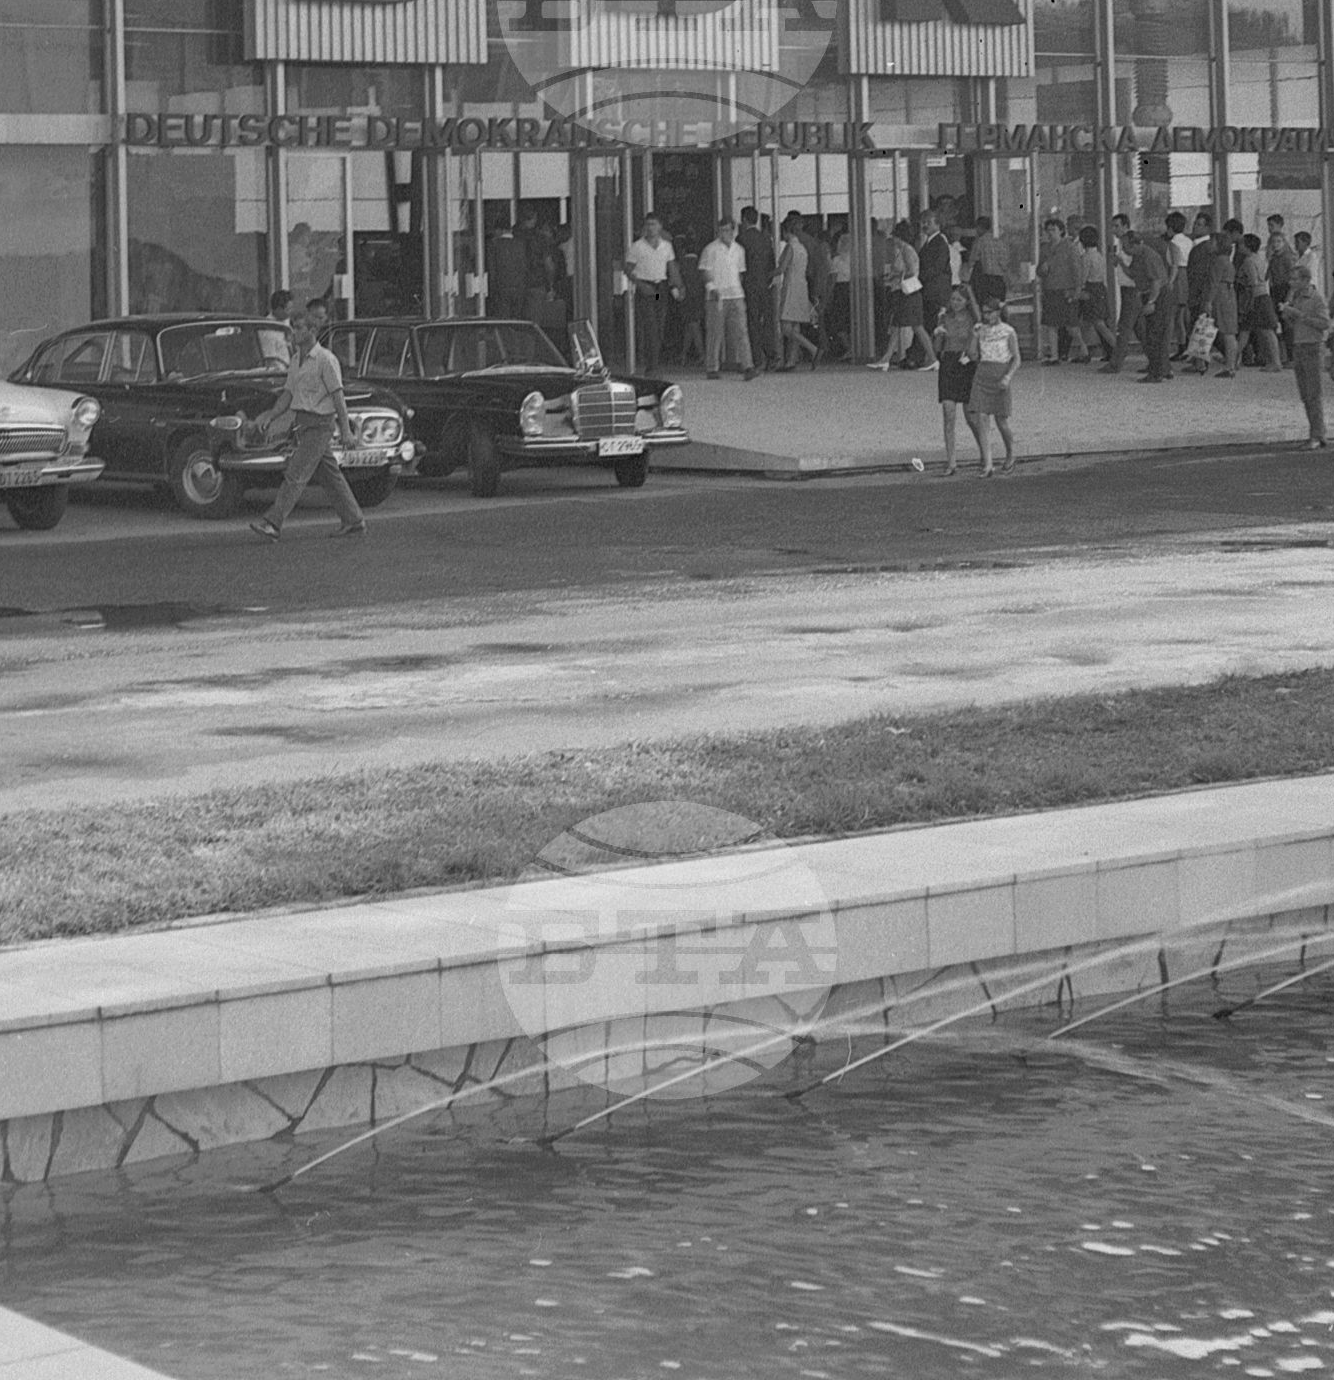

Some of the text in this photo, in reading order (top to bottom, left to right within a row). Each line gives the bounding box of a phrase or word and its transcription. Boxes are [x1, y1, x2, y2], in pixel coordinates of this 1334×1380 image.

[124, 113, 874, 150] DEUTSCHE DEMOKRATISCHE REPUBLIK
[937, 122, 1136, 152] ГЕРМАНСКА
